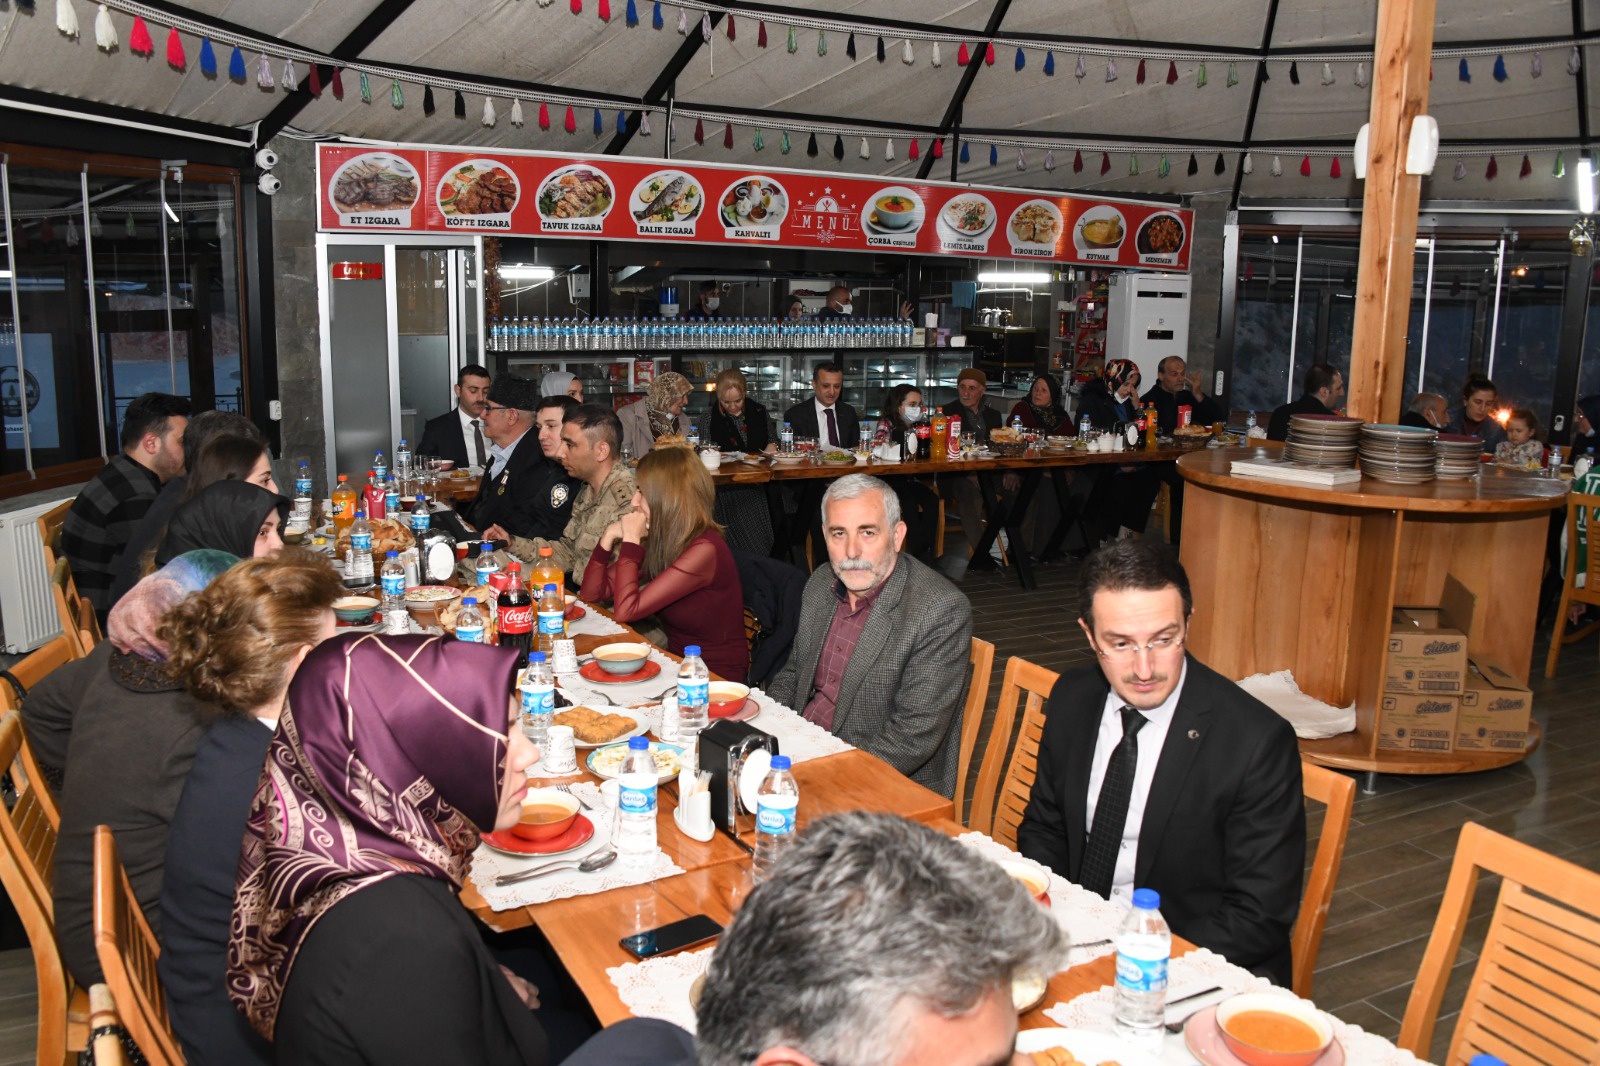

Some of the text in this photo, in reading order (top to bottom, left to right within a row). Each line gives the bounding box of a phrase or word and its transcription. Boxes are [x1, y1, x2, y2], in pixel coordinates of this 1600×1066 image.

[350, 217, 401, 225] ET IZGARA
[446, 217, 510, 228] KÖFTE IZGARA
[802, 214, 850, 231] MENÜ
[542, 222, 602, 231] TAVUK IZGARA
[639, 226, 694, 235] BALIK IZGARA
[735, 230, 771, 239] KAHVALTI
[868, 237, 892, 246] ÇORBA
[1086, 253, 1110, 261] KUYMAK
